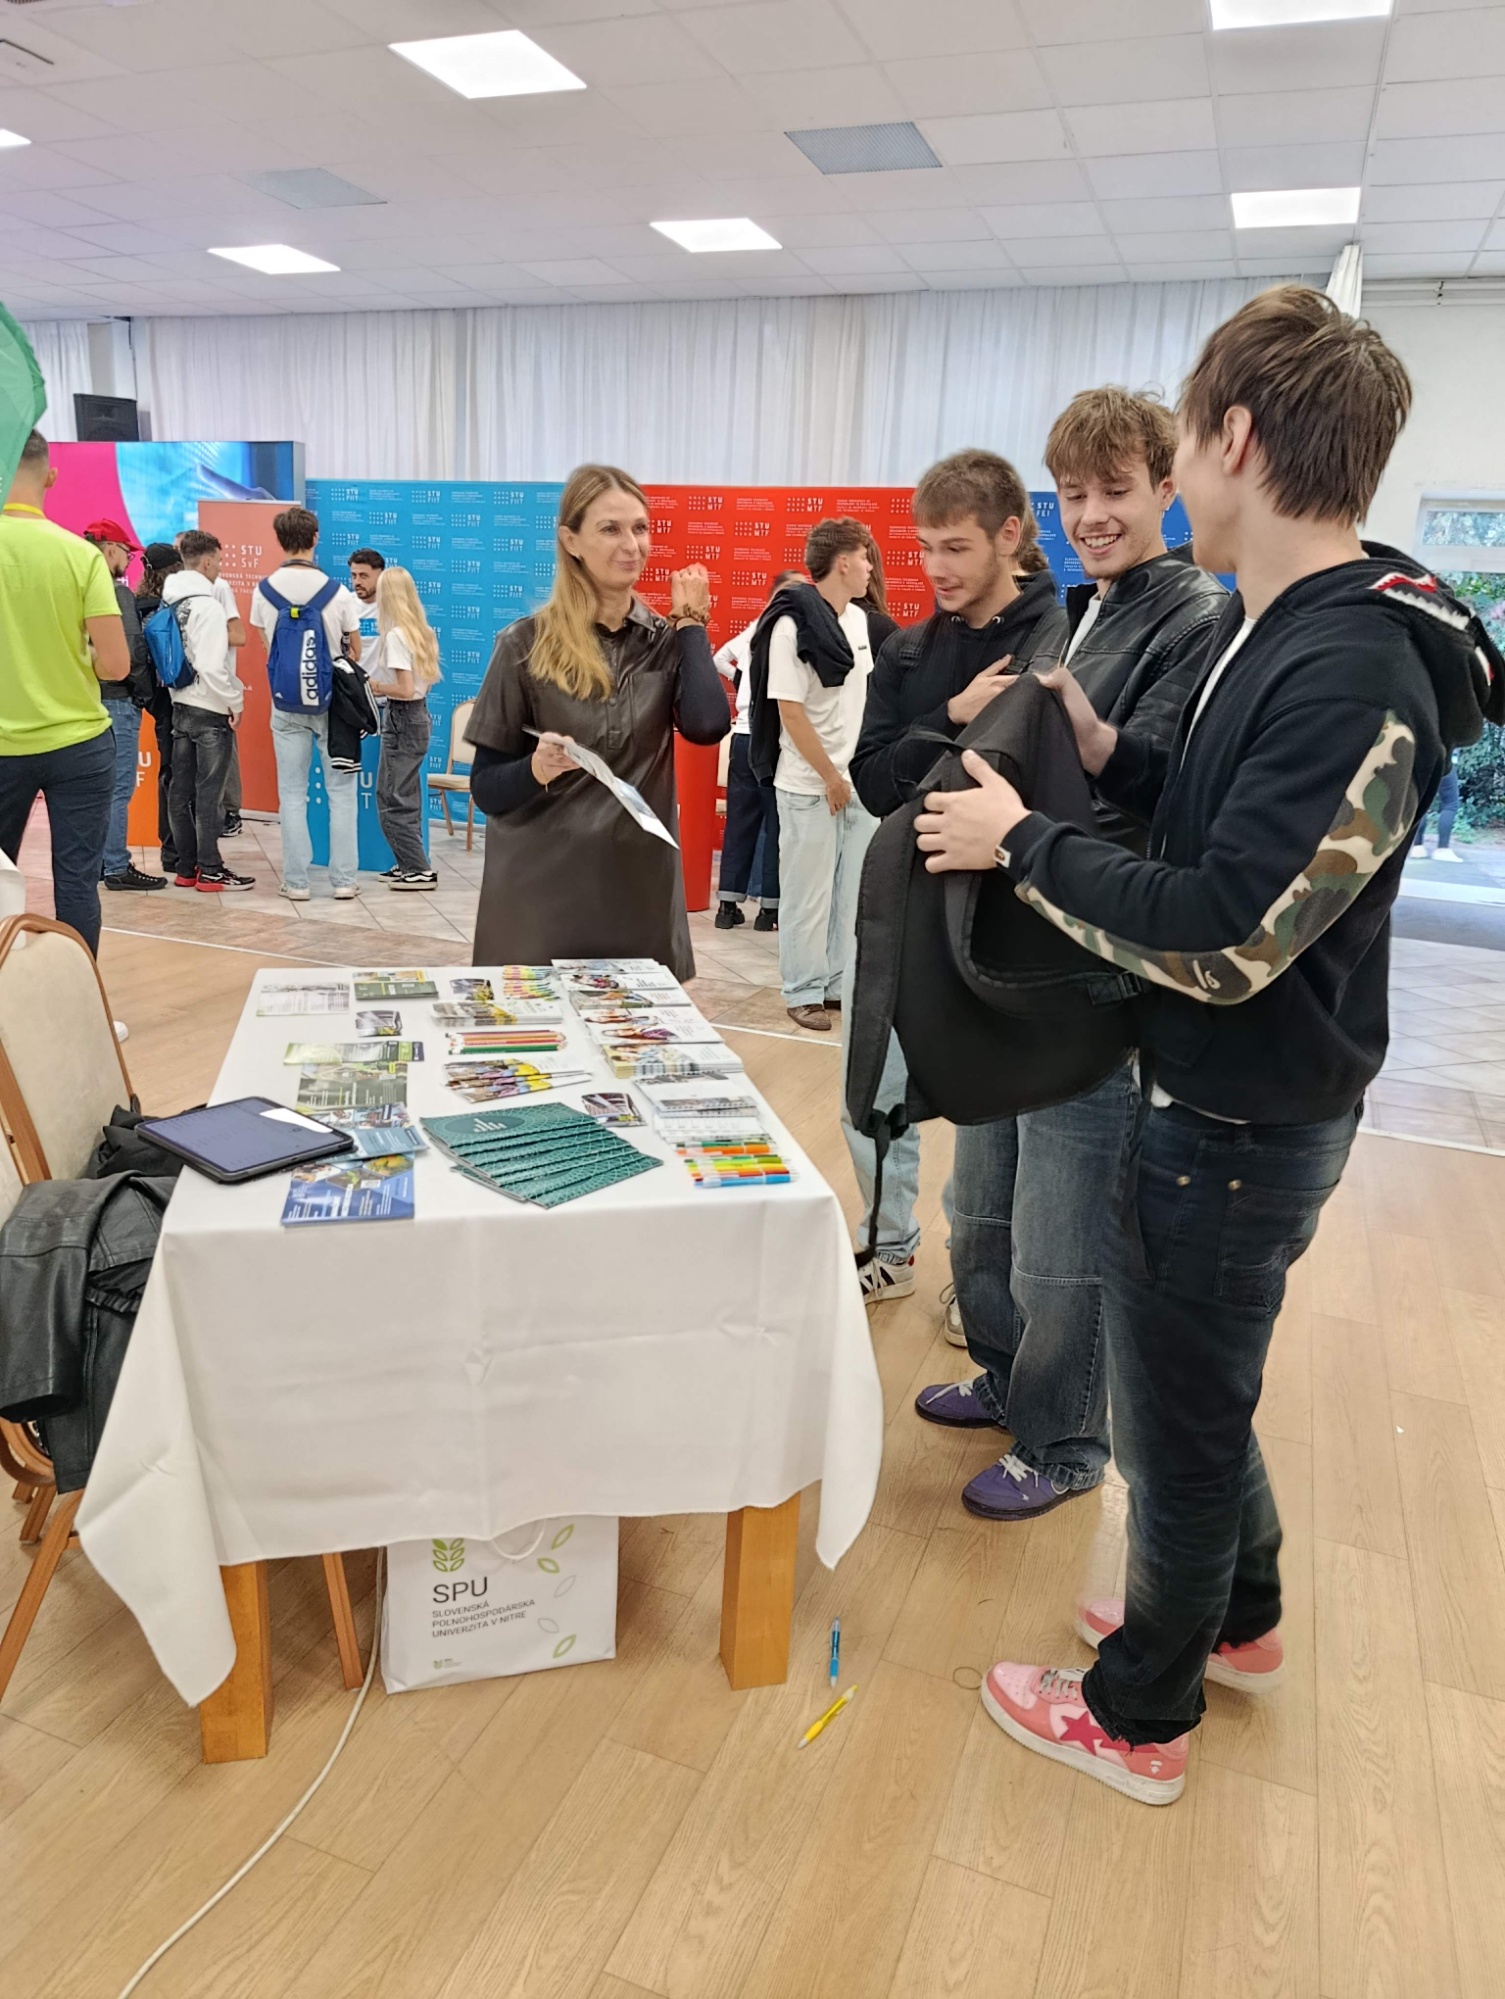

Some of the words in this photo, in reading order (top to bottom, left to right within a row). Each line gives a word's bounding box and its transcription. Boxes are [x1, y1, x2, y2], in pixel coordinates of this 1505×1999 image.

[241, 545, 262, 556] STU
[241, 558, 259, 568] SvF
[302, 636, 319, 700] adidas
[433, 1576, 488, 1603] SPU
[432, 1600, 489, 1618] SLOVENSKÁ
[432, 1621, 489, 1638] UNIVERZITA
[500, 1610, 526, 1623] NITRE
